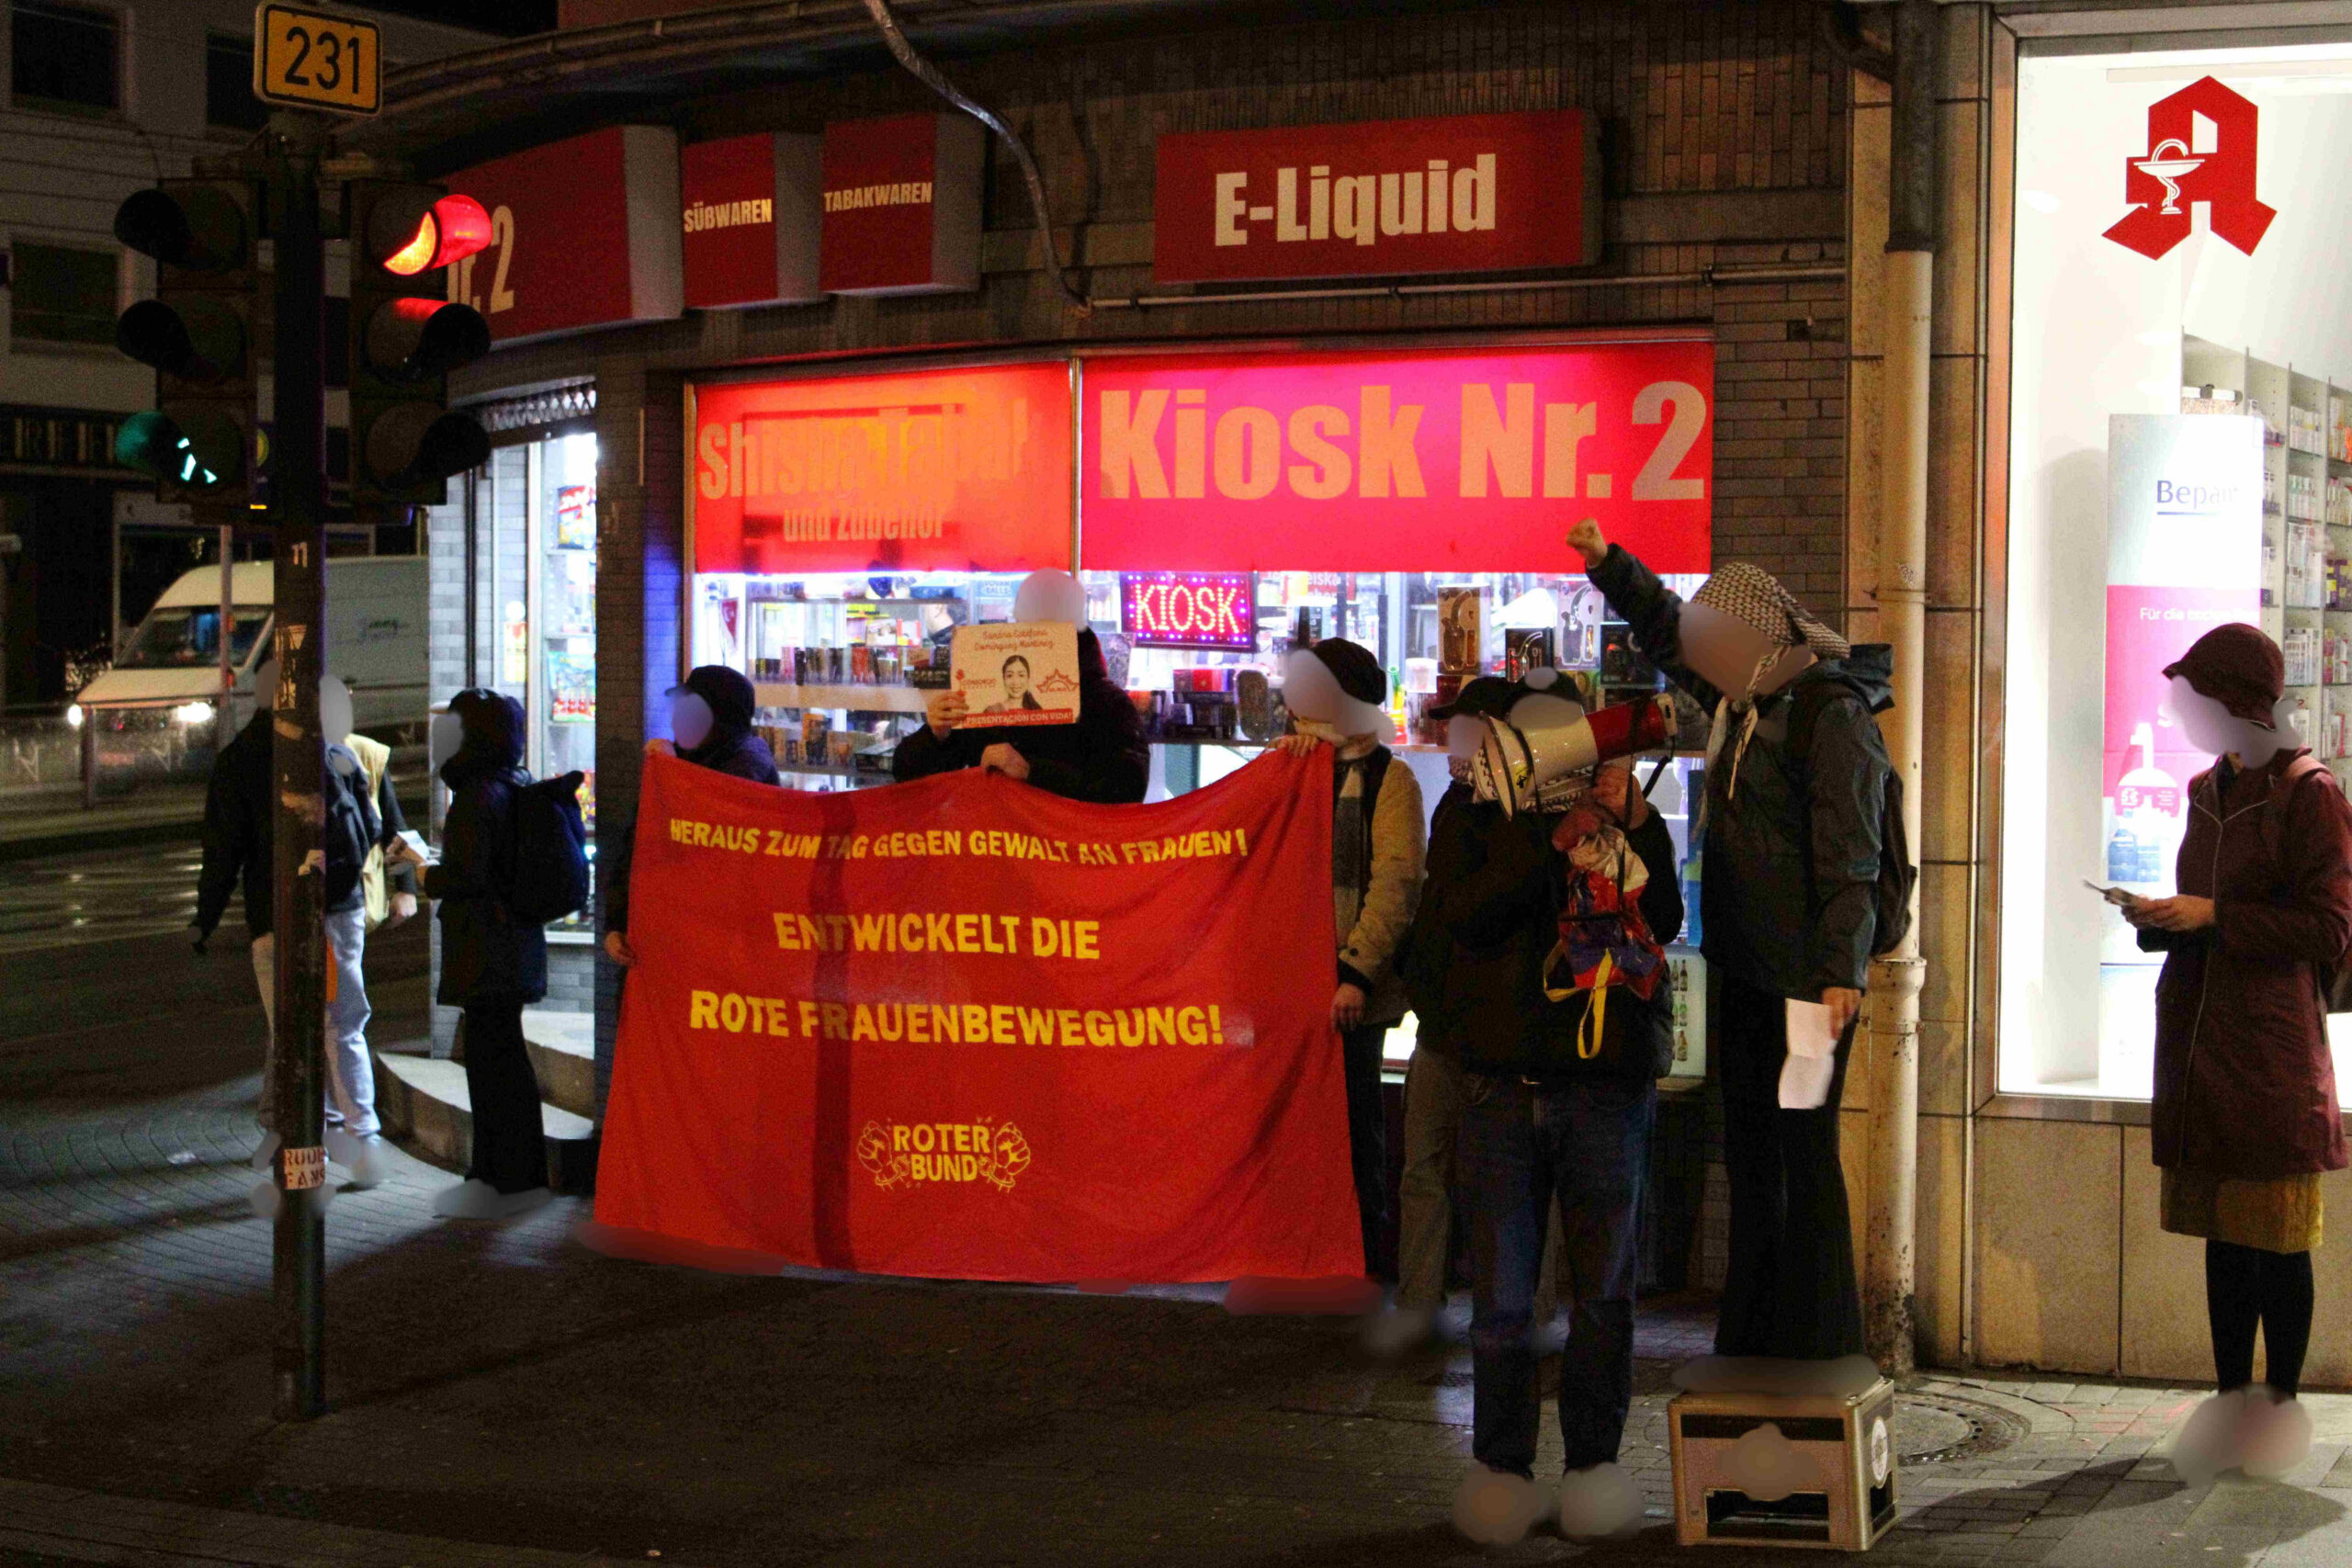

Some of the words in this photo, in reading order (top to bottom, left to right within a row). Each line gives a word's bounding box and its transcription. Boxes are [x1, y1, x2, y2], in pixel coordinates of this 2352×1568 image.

[285, 26, 359, 95] 231
[824, 182, 933, 212] TABAKWAREN
[1214, 152, 1497, 247] E-Liquid
[490, 204, 514, 314] 2
[1100, 384, 1428, 501] Kiosk
[1459, 382, 1612, 499] Nr.
[1630, 379, 1708, 502] 2
[1134, 582, 1239, 635] KIOSK
[671, 818, 761, 854] HERAUS
[764, 829, 822, 859] ZUM
[827, 835, 870, 859] TAG
[873, 829, 962, 858] GEGEN
[969, 829, 1070, 863] GEWALT
[1079, 842, 1118, 865] AN
[773, 912, 1021, 954] ENTWICKELT
[1031, 917, 1101, 960] DIE
[690, 989, 790, 1038] ROTE
[797, 1000, 1224, 1047] FRAUENBEWEGUNG!
[893, 1122, 991, 1154] ROTER
[910, 1154, 978, 1182] BUND
